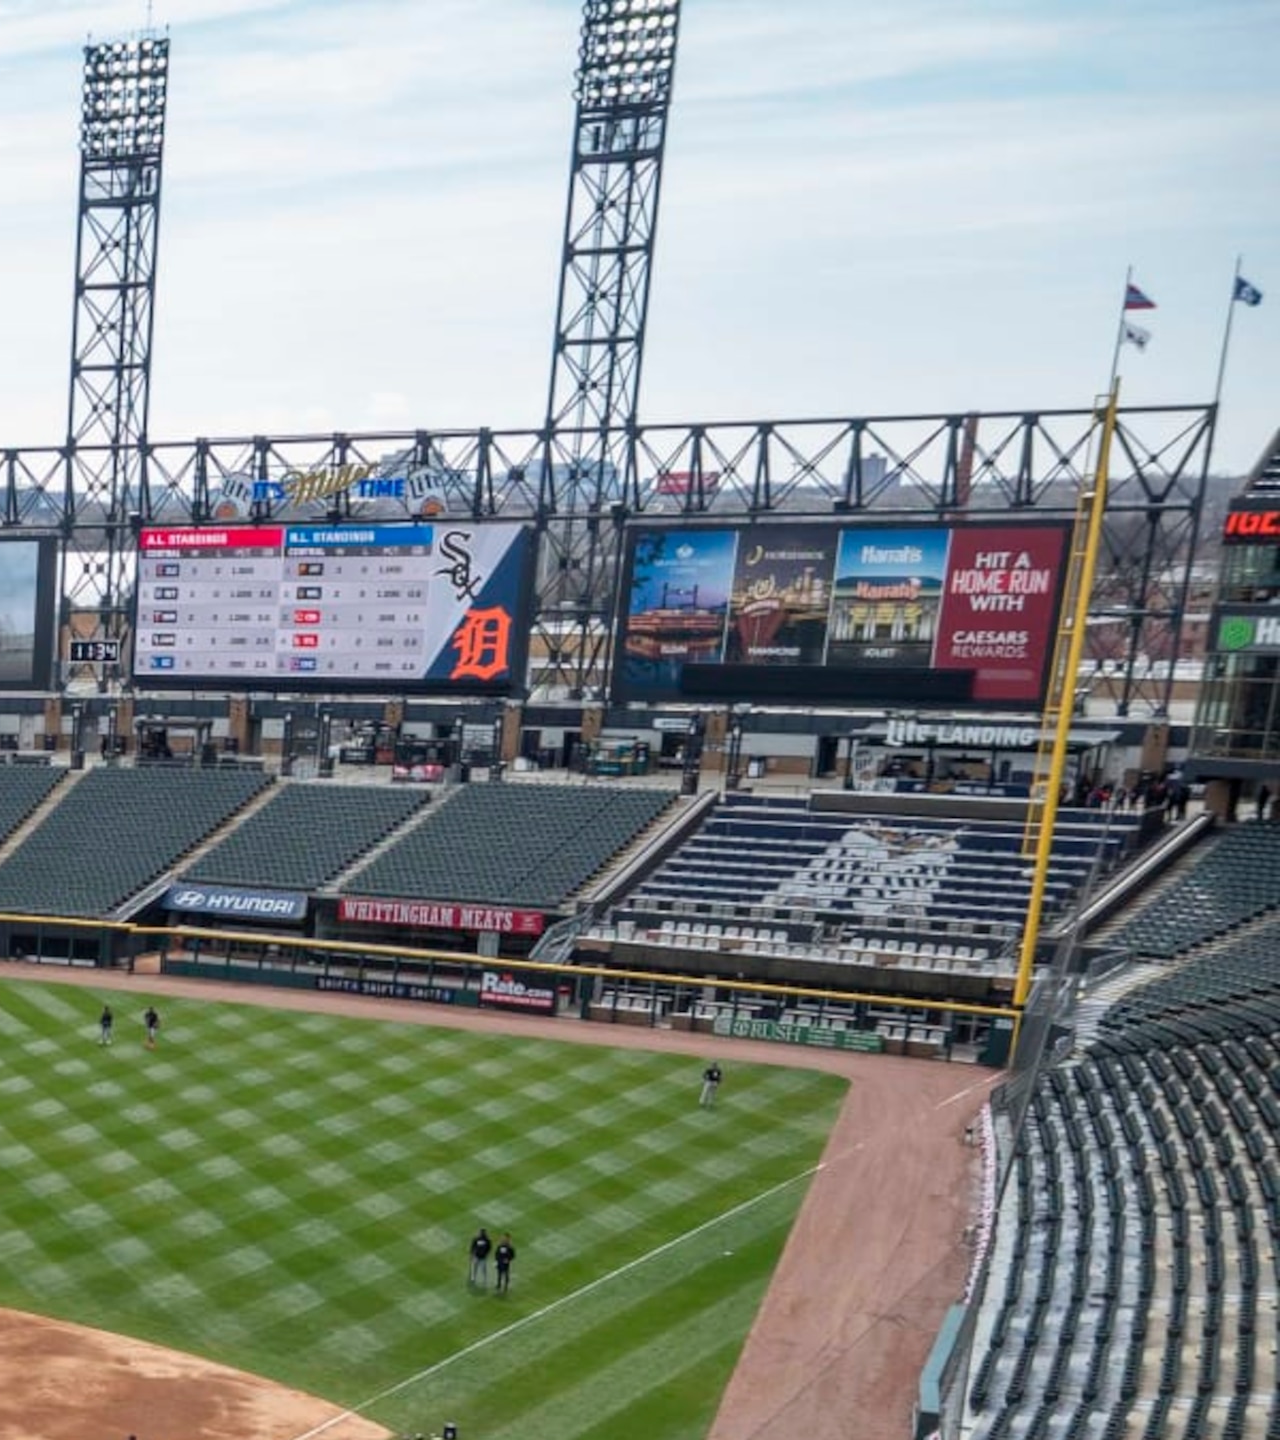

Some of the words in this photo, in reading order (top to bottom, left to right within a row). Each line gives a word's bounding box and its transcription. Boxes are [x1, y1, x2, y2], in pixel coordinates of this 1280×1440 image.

[358, 477, 406, 498] TIME
[975, 551, 1010, 569] HIT
[1015, 551, 1032, 569] A
[951, 569, 1006, 594] HOME
[1008, 568, 1051, 594] RUN
[970, 594, 1024, 611] WITH
[952, 630, 1028, 645] CAESARS
[936, 726, 1038, 746] LANDING
[206, 895, 297, 915] HYUNDAI
[343, 899, 456, 929] WHITTINGHAM
[458, 905, 514, 932] MEATS
[750, 1021, 802, 1043] RUSH
